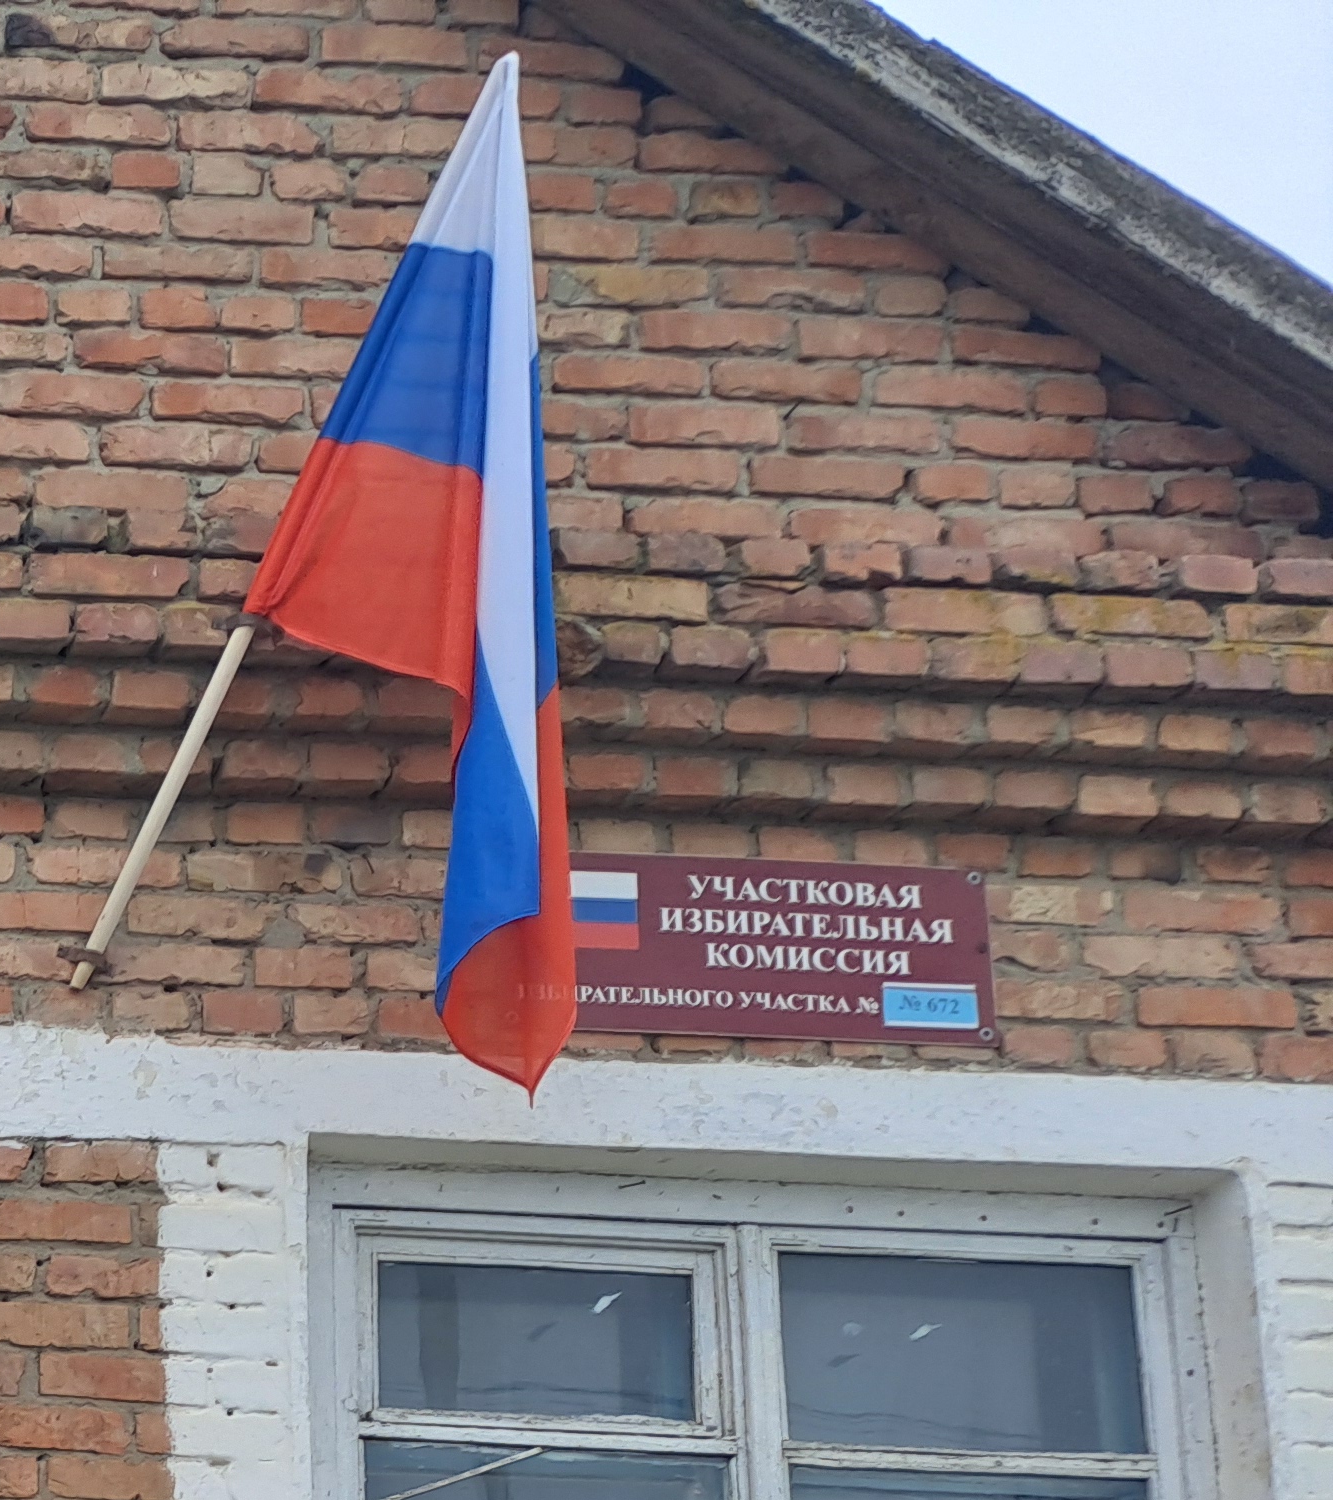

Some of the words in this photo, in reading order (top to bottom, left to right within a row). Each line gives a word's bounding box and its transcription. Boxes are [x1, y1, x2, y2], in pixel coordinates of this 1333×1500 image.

[686, 874, 922, 910] УЧАСТКОВАЯ
[660, 906, 954, 945] ИЗБИРАТЕЛЬНАЯ
[706, 942, 911, 976] КОМИССИЯ
[573, 984, 734, 1009] РАТЕЛЬНОГО
[739, 991, 852, 1014] УЧАСТКА
[855, 996, 880, 1015] №
[926, 996, 960, 1015] 672
